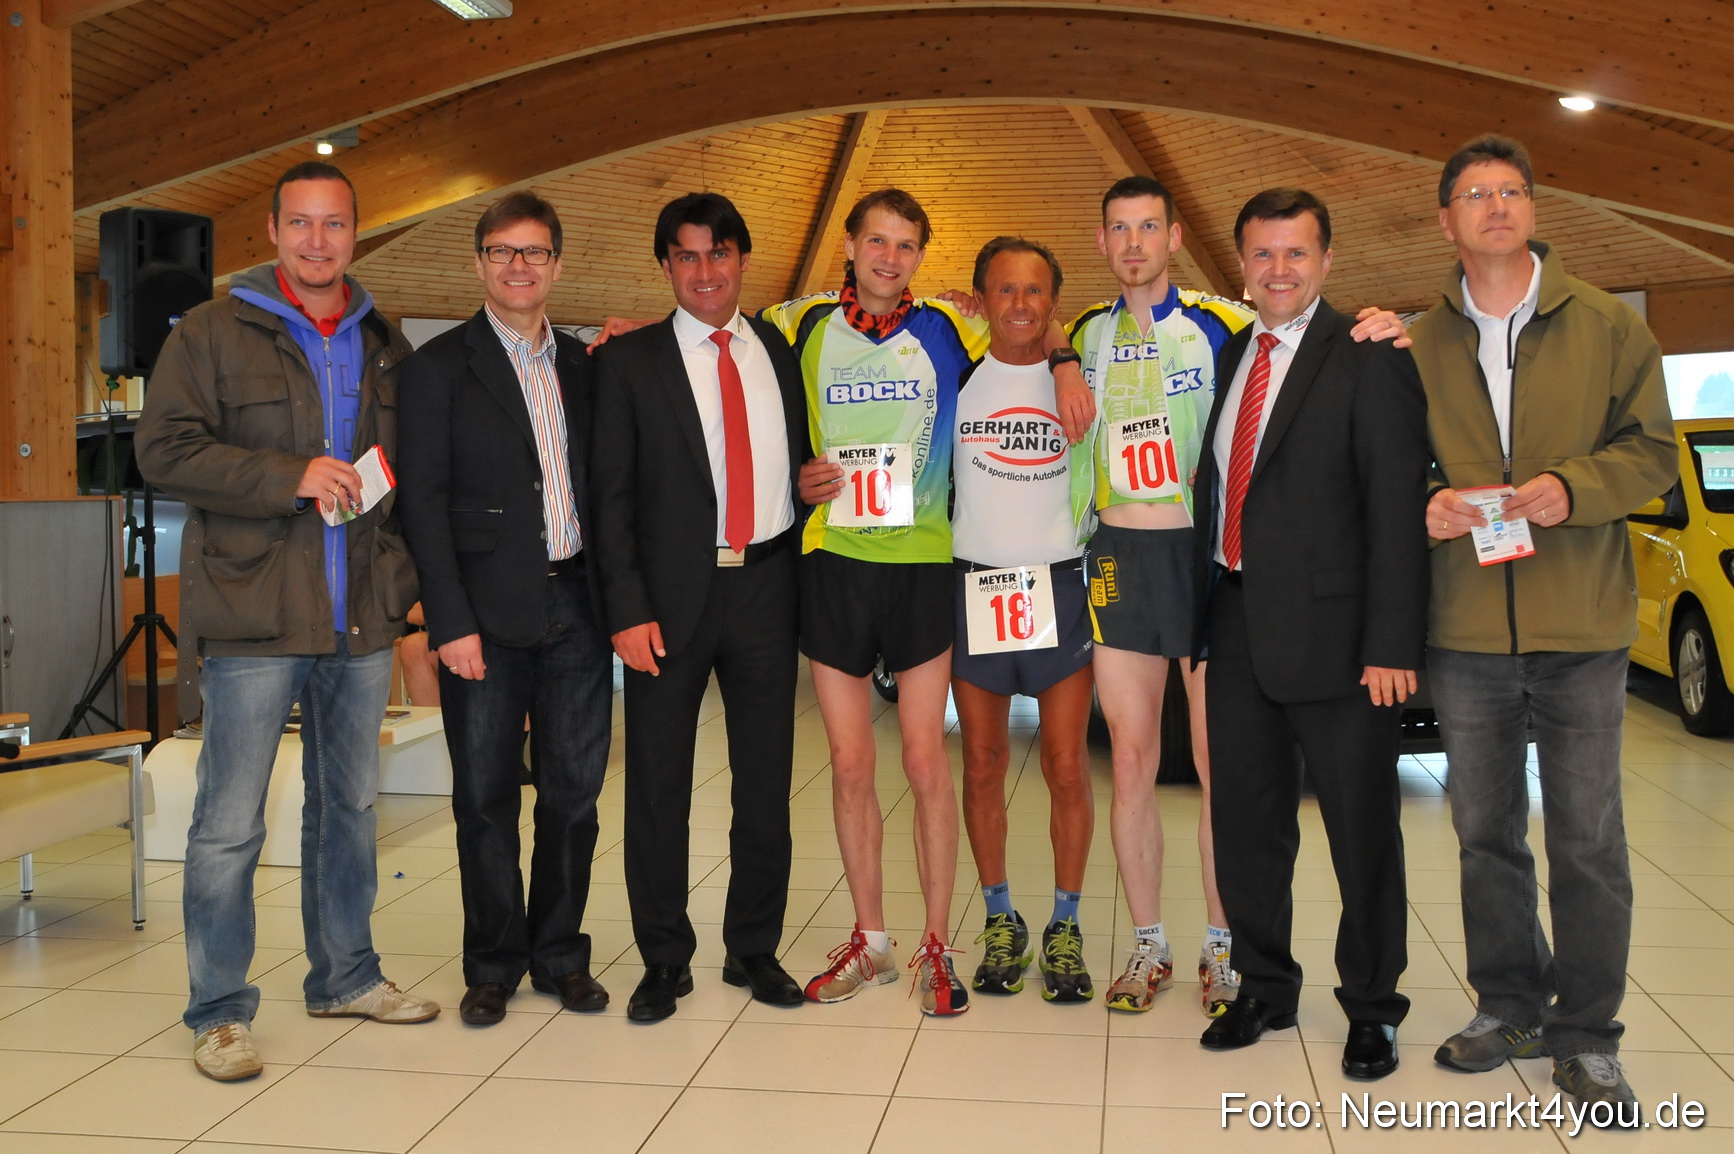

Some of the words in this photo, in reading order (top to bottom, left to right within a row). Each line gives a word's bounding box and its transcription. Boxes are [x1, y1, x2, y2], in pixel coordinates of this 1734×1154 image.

[830, 364, 888, 381] TEAM
[827, 379, 922, 405] BOCK
[959, 421, 1052, 436] GERHART
[1053, 428, 1061, 437] &
[1122, 418, 1160, 435] MEYER
[1122, 427, 1163, 441] WERBUNG
[960, 435, 1001, 444] Autohaus
[1000, 435, 1061, 453] JÄNIG
[838, 448, 877, 460] MEYER
[840, 456, 878, 467] WERBUNG
[971, 456, 987, 471] Das
[987, 466, 1031, 482] sportliche
[1032, 465, 1068, 482] Autohaus
[850, 468, 893, 518] 10
[978, 572, 1017, 586] MEYER
[978, 582, 1019, 593] WERBUNG
[990, 591, 1035, 642] 18
[1138, 926, 1160, 936] SOCKS
